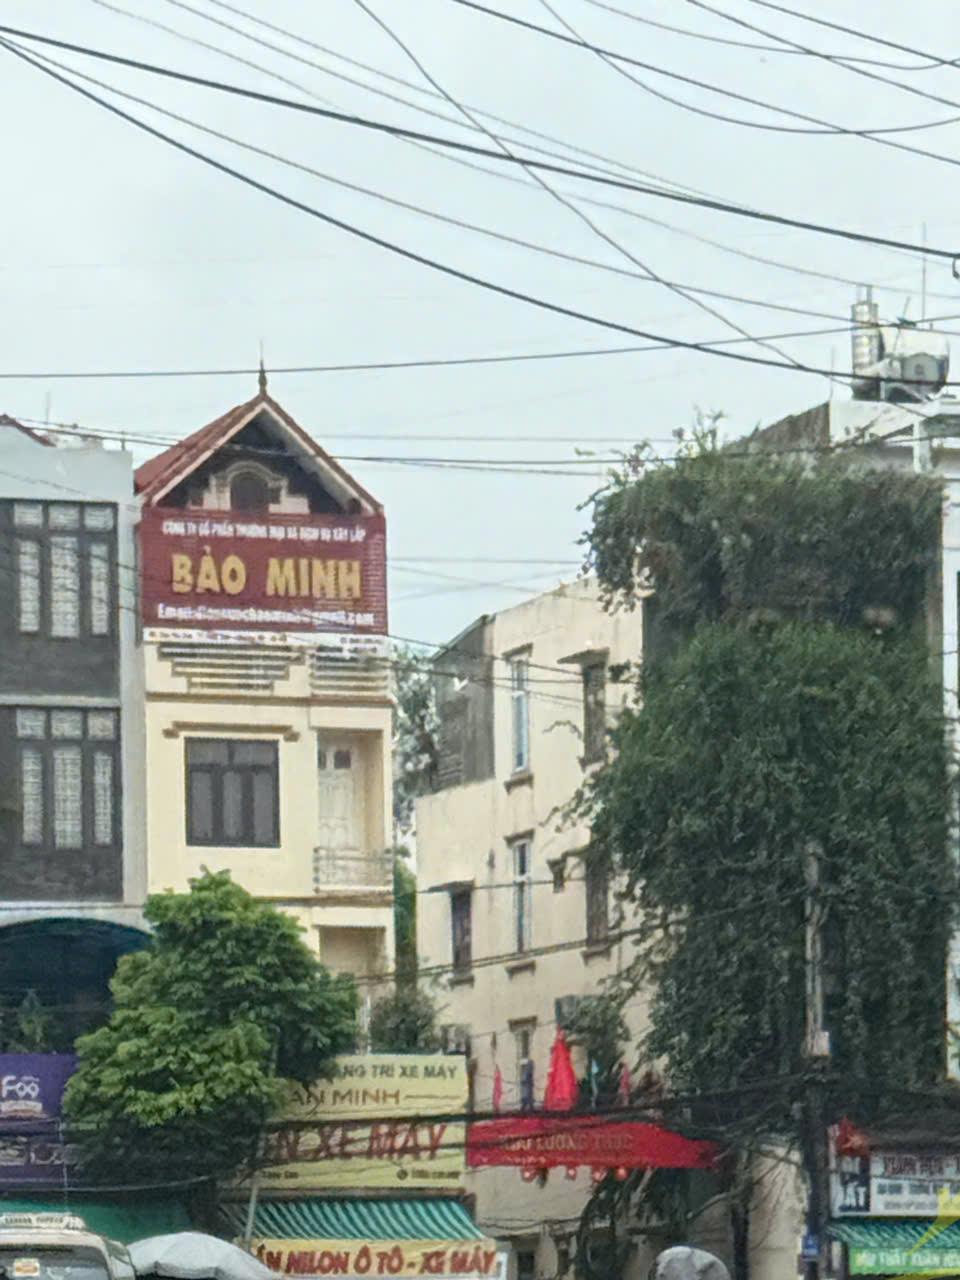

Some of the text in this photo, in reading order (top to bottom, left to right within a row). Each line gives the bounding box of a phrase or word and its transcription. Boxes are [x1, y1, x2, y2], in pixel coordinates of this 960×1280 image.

[172, 545, 362, 599] BẢO MINH
[400, 1064, 419, 1078] XE
[333, 1088, 400, 1105] MINH
[285, 1250, 349, 1274] NILON
[354, 1244, 371, 1274] Ô
[377, 1244, 404, 1274] TÔ
[421, 1250, 446, 1274] XE
[450, 1245, 496, 1274] MÁY
